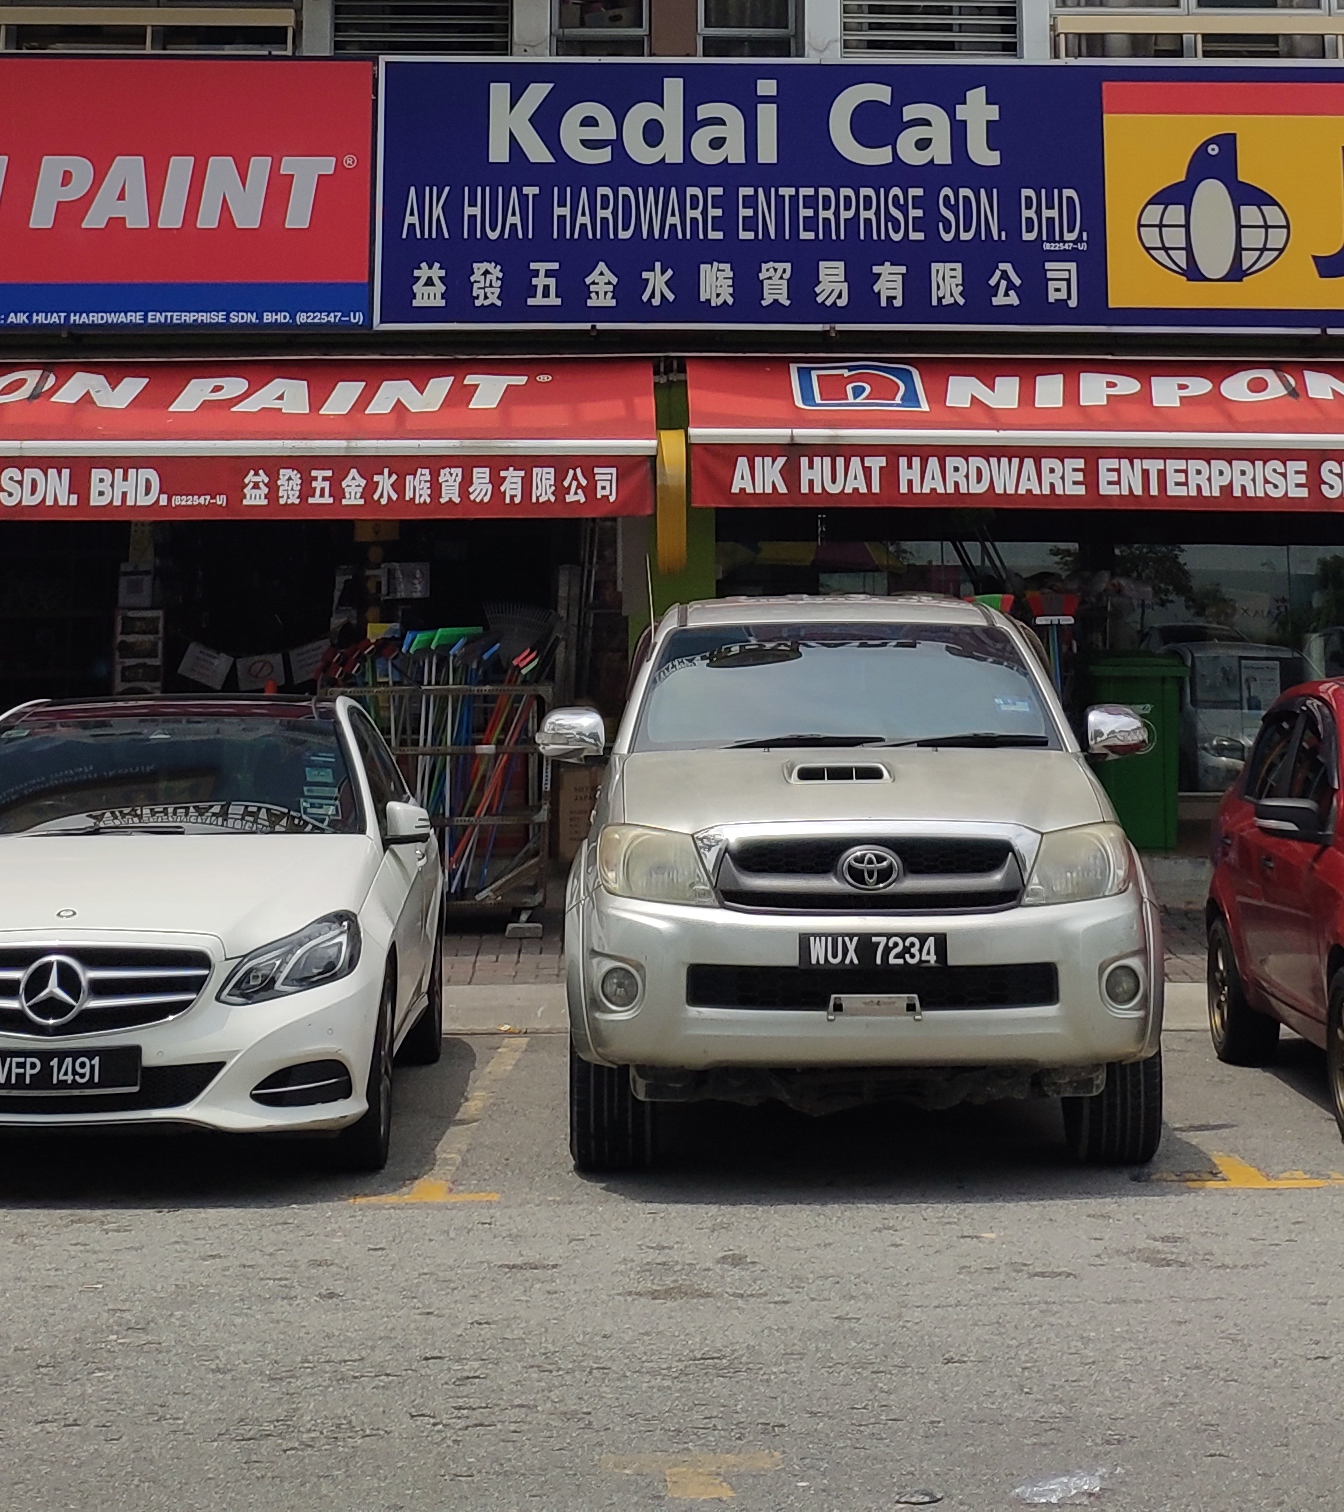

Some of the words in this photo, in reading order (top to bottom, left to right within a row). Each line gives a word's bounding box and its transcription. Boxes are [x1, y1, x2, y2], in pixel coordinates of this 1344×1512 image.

[487, 77, 778, 166] Kedai
[828, 83, 1000, 167] Cat
[29, 155, 336, 231] PAINT
[402, 186, 450, 241] AIK
[462, 186, 540, 241] HUAT
[553, 186, 724, 242] HARDWARE
[737, 187, 925, 242] ENTERPRISE
[937, 187, 1007, 242] SDN.
[1019, 188, 1088, 242] BHD.
[6, 311, 30, 325] AIK
[32, 311, 67, 325] HUAT
[69, 311, 144, 326] HARDWARE
[147, 311, 226, 326] ENTERPRISE
[229, 311, 260, 326] SDN.
[263, 311, 293, 326] BHD.
[168, 375, 529, 414] PAINT
[0, 468, 78, 507] SDN.
[89, 468, 168, 507] BHD.
[731, 456, 789, 495] AIK
[800, 456, 888, 496] HUAT
[898, 457, 1087, 498] HARDWARE
[1099, 458, 1310, 499] ENTERPRISE
[809, 937, 860, 965] WUX
[871, 936, 938, 965] 7234
[49, 1055, 100, 1084] 1491
